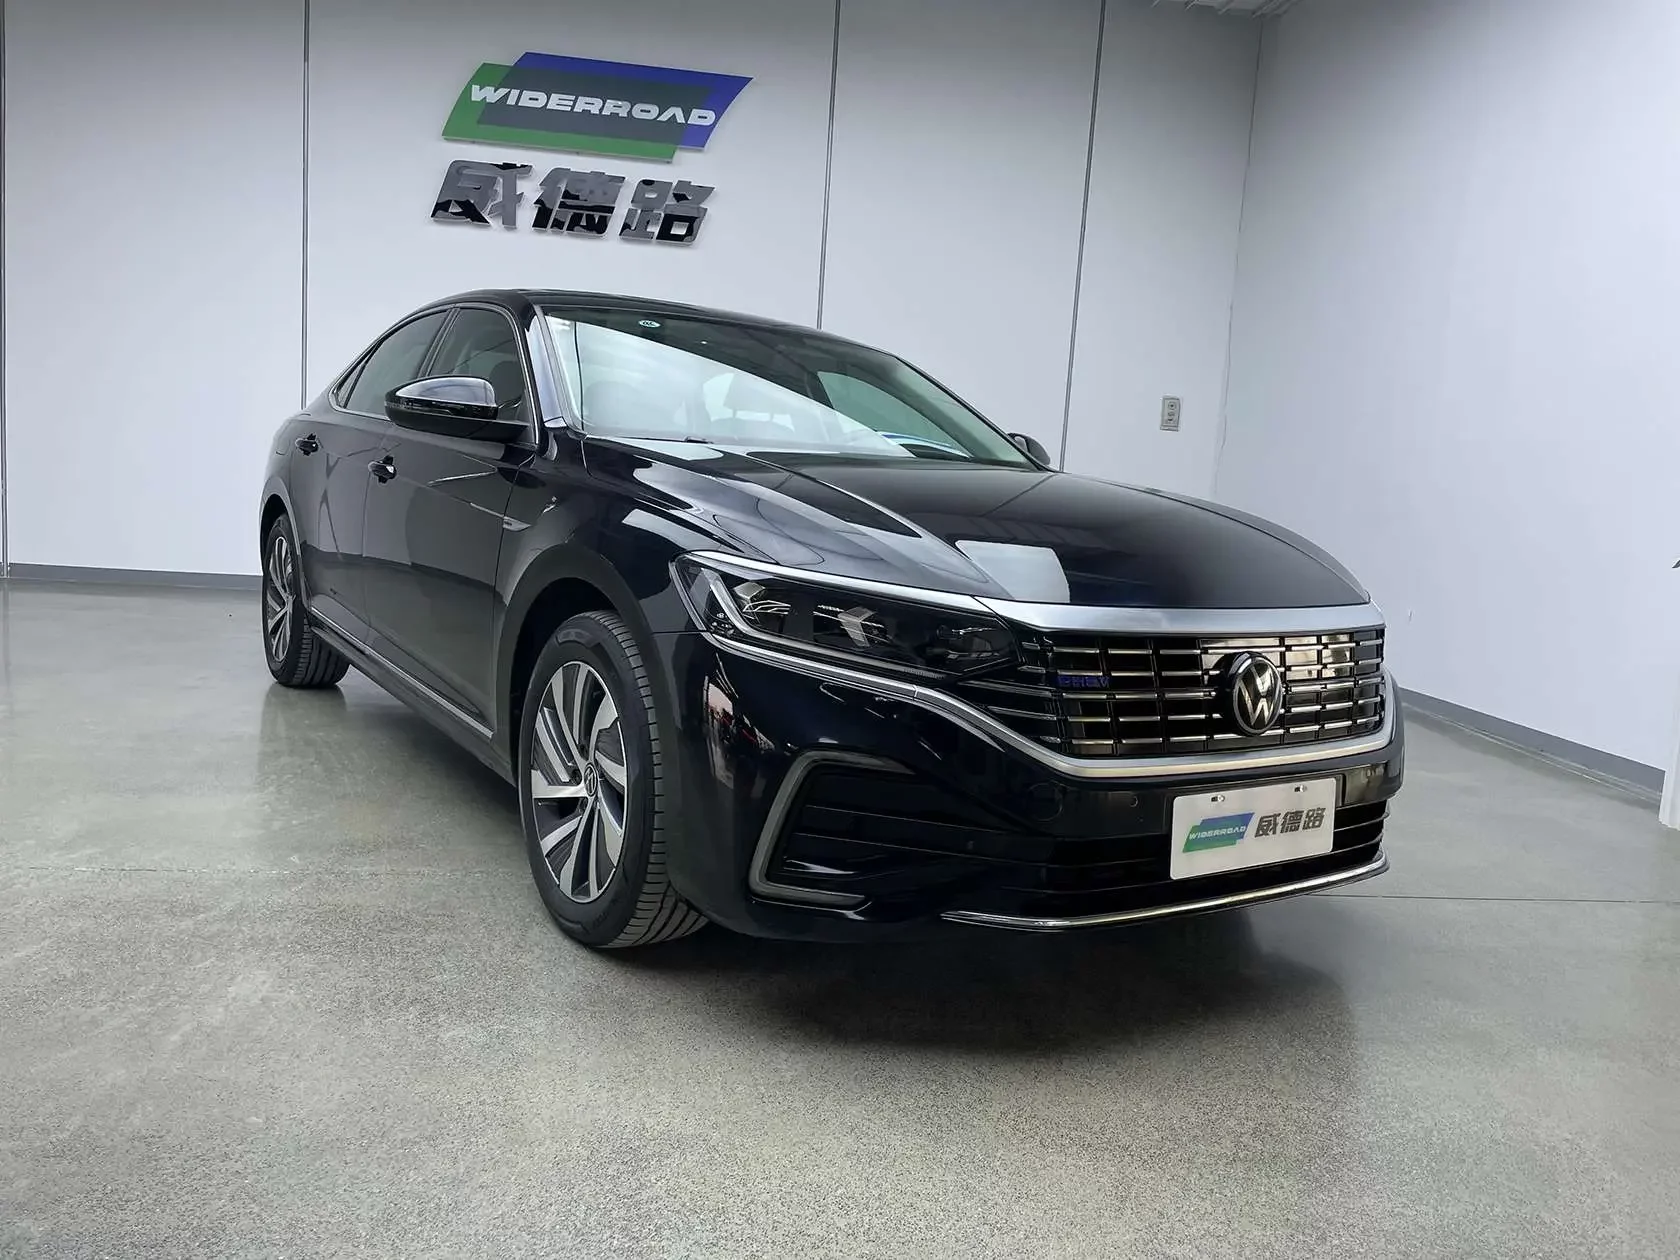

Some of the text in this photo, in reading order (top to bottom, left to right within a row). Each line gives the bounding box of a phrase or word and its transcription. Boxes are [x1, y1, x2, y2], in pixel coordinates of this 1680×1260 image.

[471, 84, 716, 126] WIDERROAD
[430, 160, 716, 243] 威德路
[1189, 826, 1246, 840] WIDERROAD
[1254, 807, 1326, 838] 威德路
